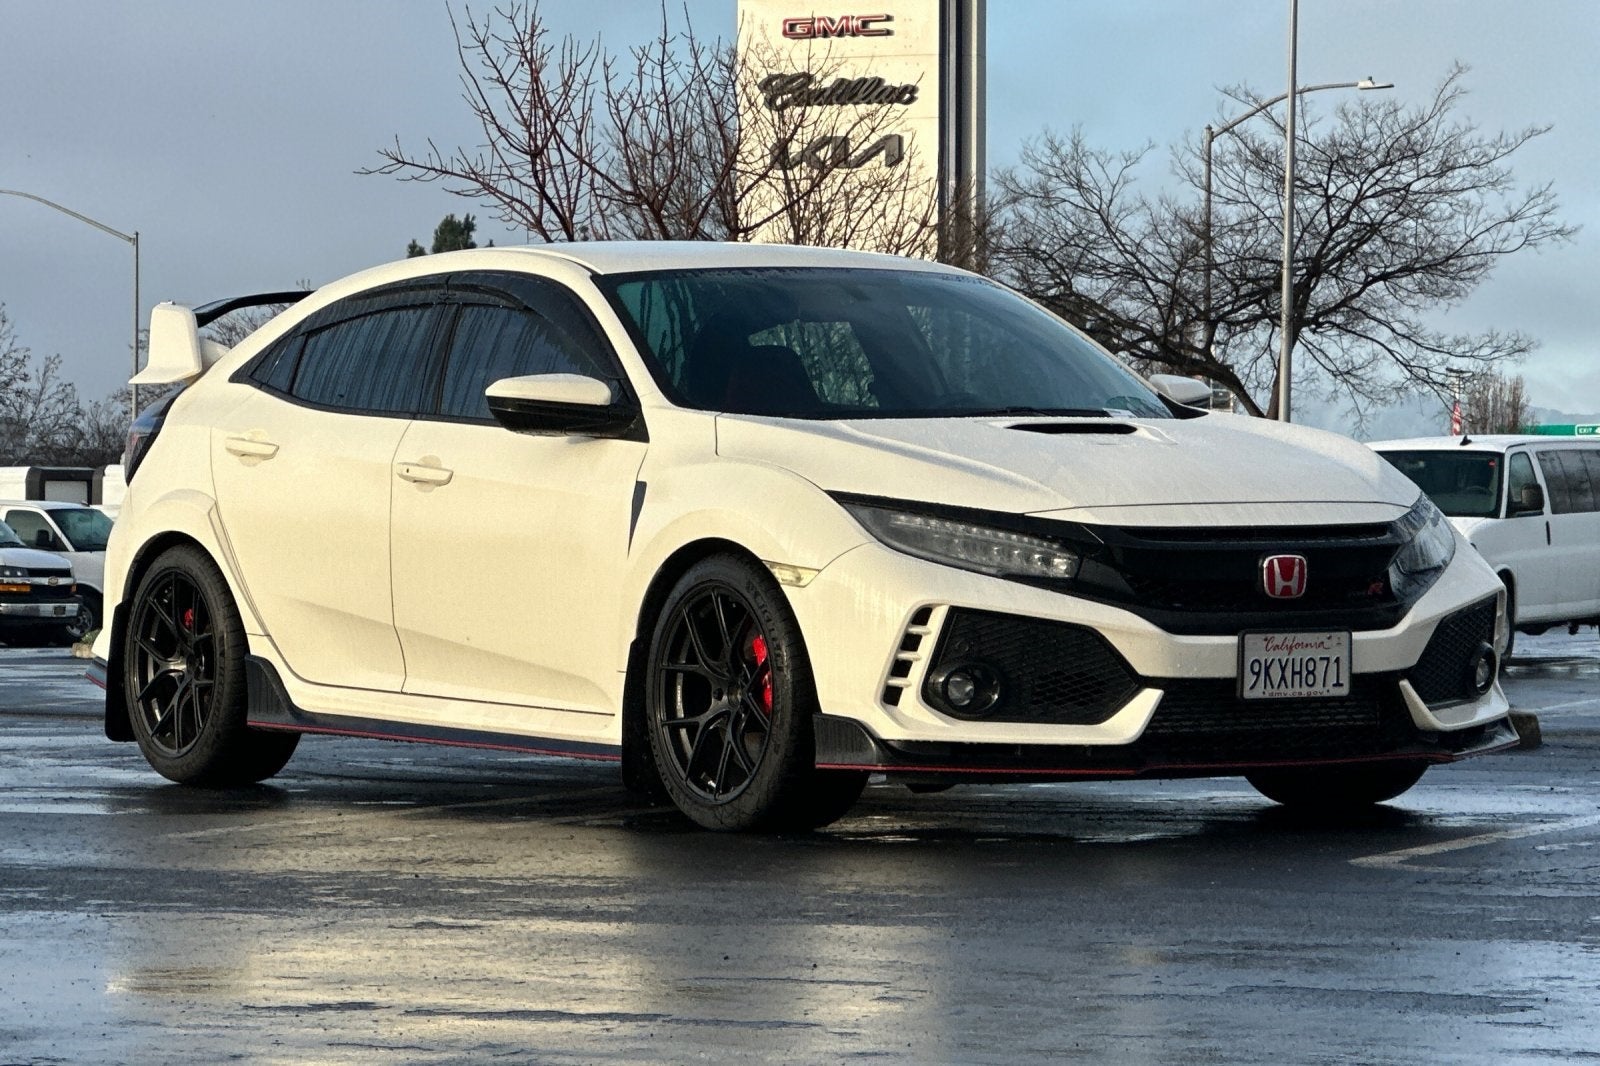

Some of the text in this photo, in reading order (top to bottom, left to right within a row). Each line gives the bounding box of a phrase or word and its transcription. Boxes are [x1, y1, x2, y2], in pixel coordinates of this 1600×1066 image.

[782, 14, 894, 39] GMC
[1264, 636, 1331, 655] California
[1249, 656, 1344, 691] 9KXH871
